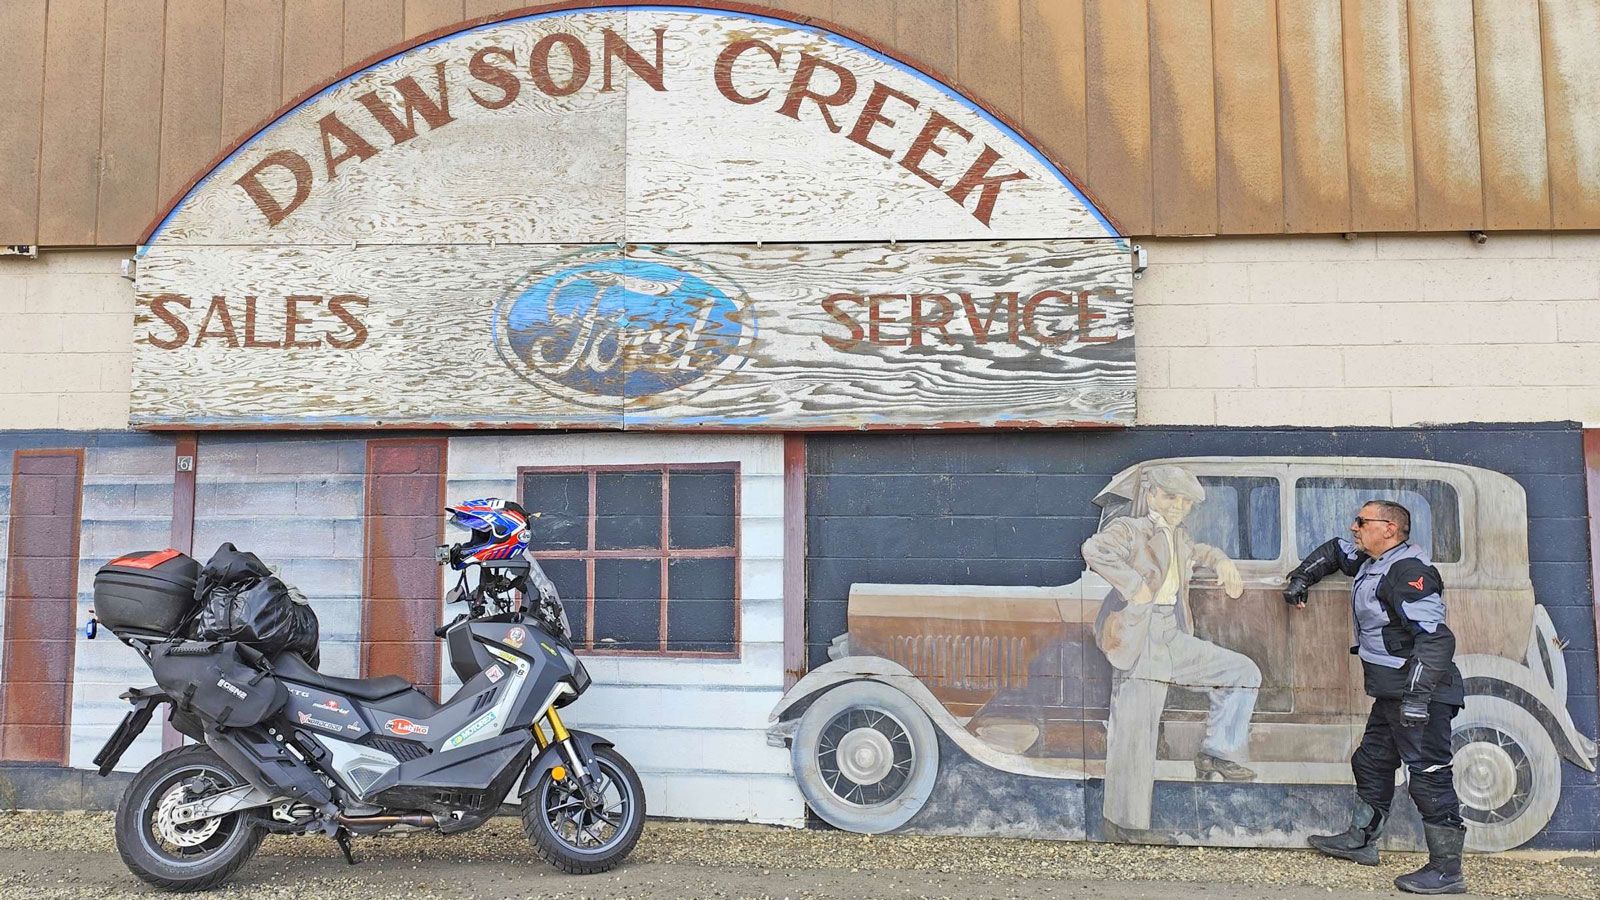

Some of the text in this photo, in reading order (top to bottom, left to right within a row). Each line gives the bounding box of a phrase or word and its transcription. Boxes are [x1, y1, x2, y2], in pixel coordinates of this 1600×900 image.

[234, 28, 1030, 229] DAWSON CREEK
[148, 293, 370, 350] SALES
[530, 270, 717, 374] Ford
[821, 291, 1119, 351] SERVICE
[180, 457, 188, 470] 6
[460, 711, 496, 740] MOTOREX
